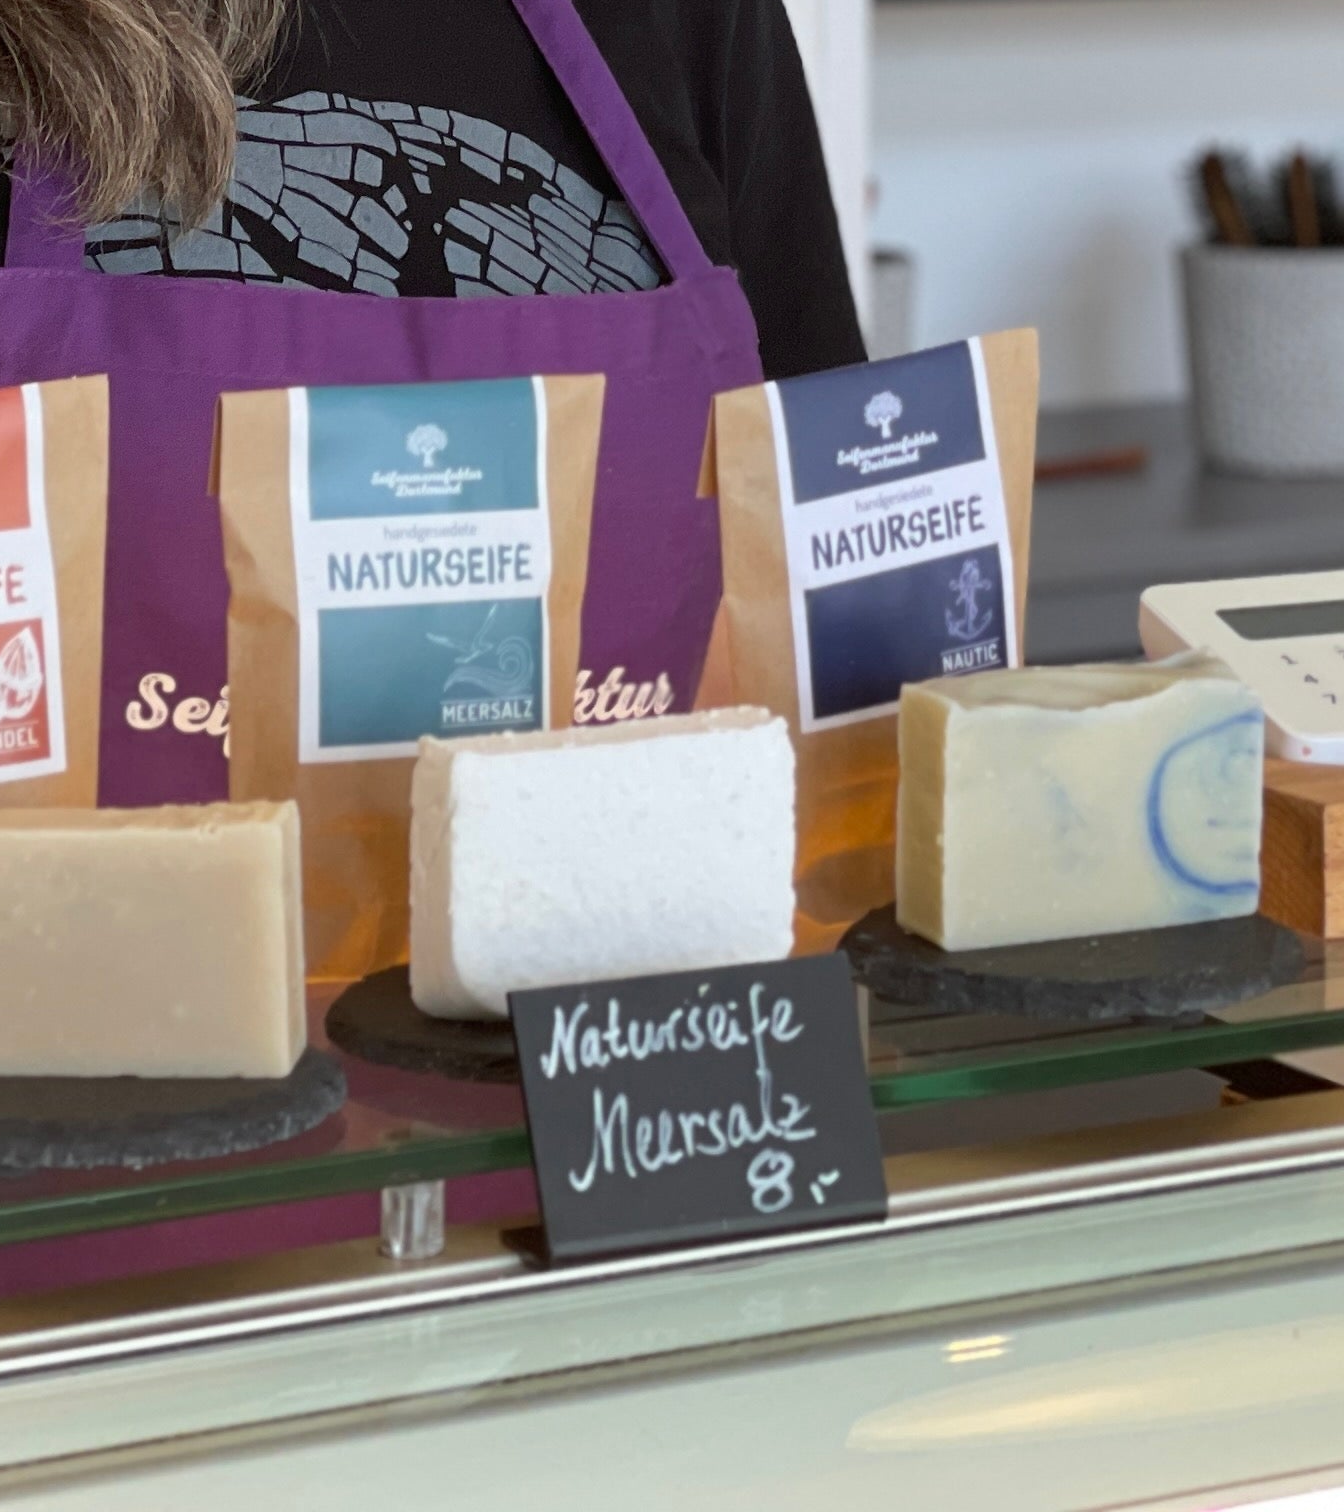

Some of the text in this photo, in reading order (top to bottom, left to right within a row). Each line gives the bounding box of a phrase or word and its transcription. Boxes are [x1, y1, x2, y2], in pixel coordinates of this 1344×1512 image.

[327, 542, 533, 592] NATURSEIFE
[811, 494, 985, 571] NATURSEIFE
[942, 643, 998, 673] NAUTIC
[126, 666, 674, 759] Sei ktur
[442, 699, 533, 724] MEERSALZ
[540, 982, 805, 1079] Naturseife
[568, 1071, 817, 1192] Meersalz
